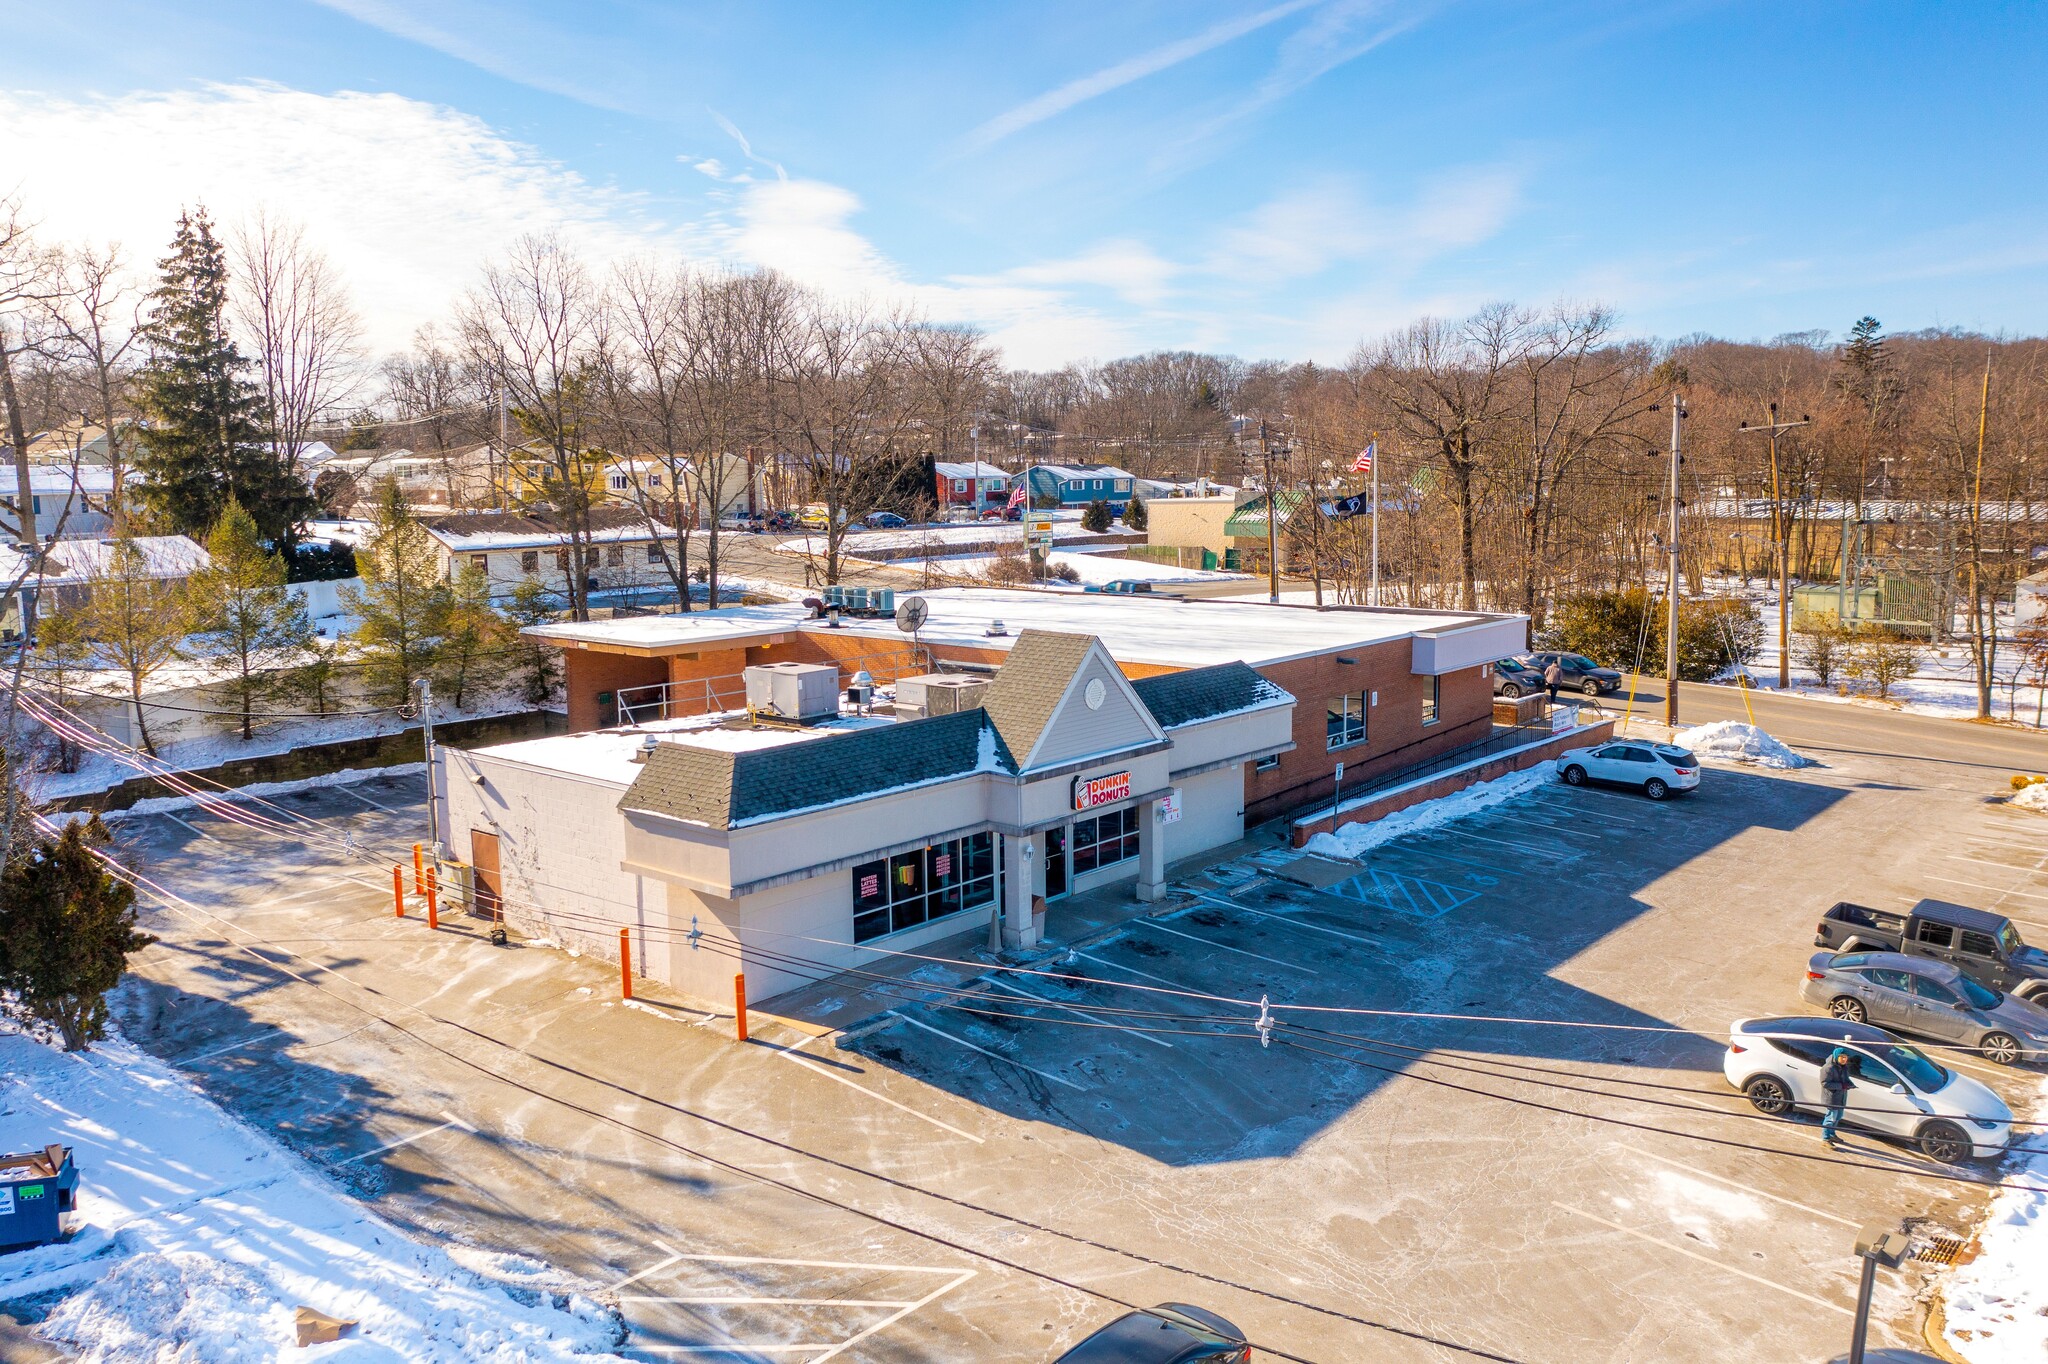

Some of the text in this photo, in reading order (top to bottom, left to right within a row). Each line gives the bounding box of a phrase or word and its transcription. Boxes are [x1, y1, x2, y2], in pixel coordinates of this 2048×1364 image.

[1091, 773, 1131, 793] DUNKIN'
[1092, 785, 1130, 805] DONUTS
[861, 879, 877, 887] LATTES
